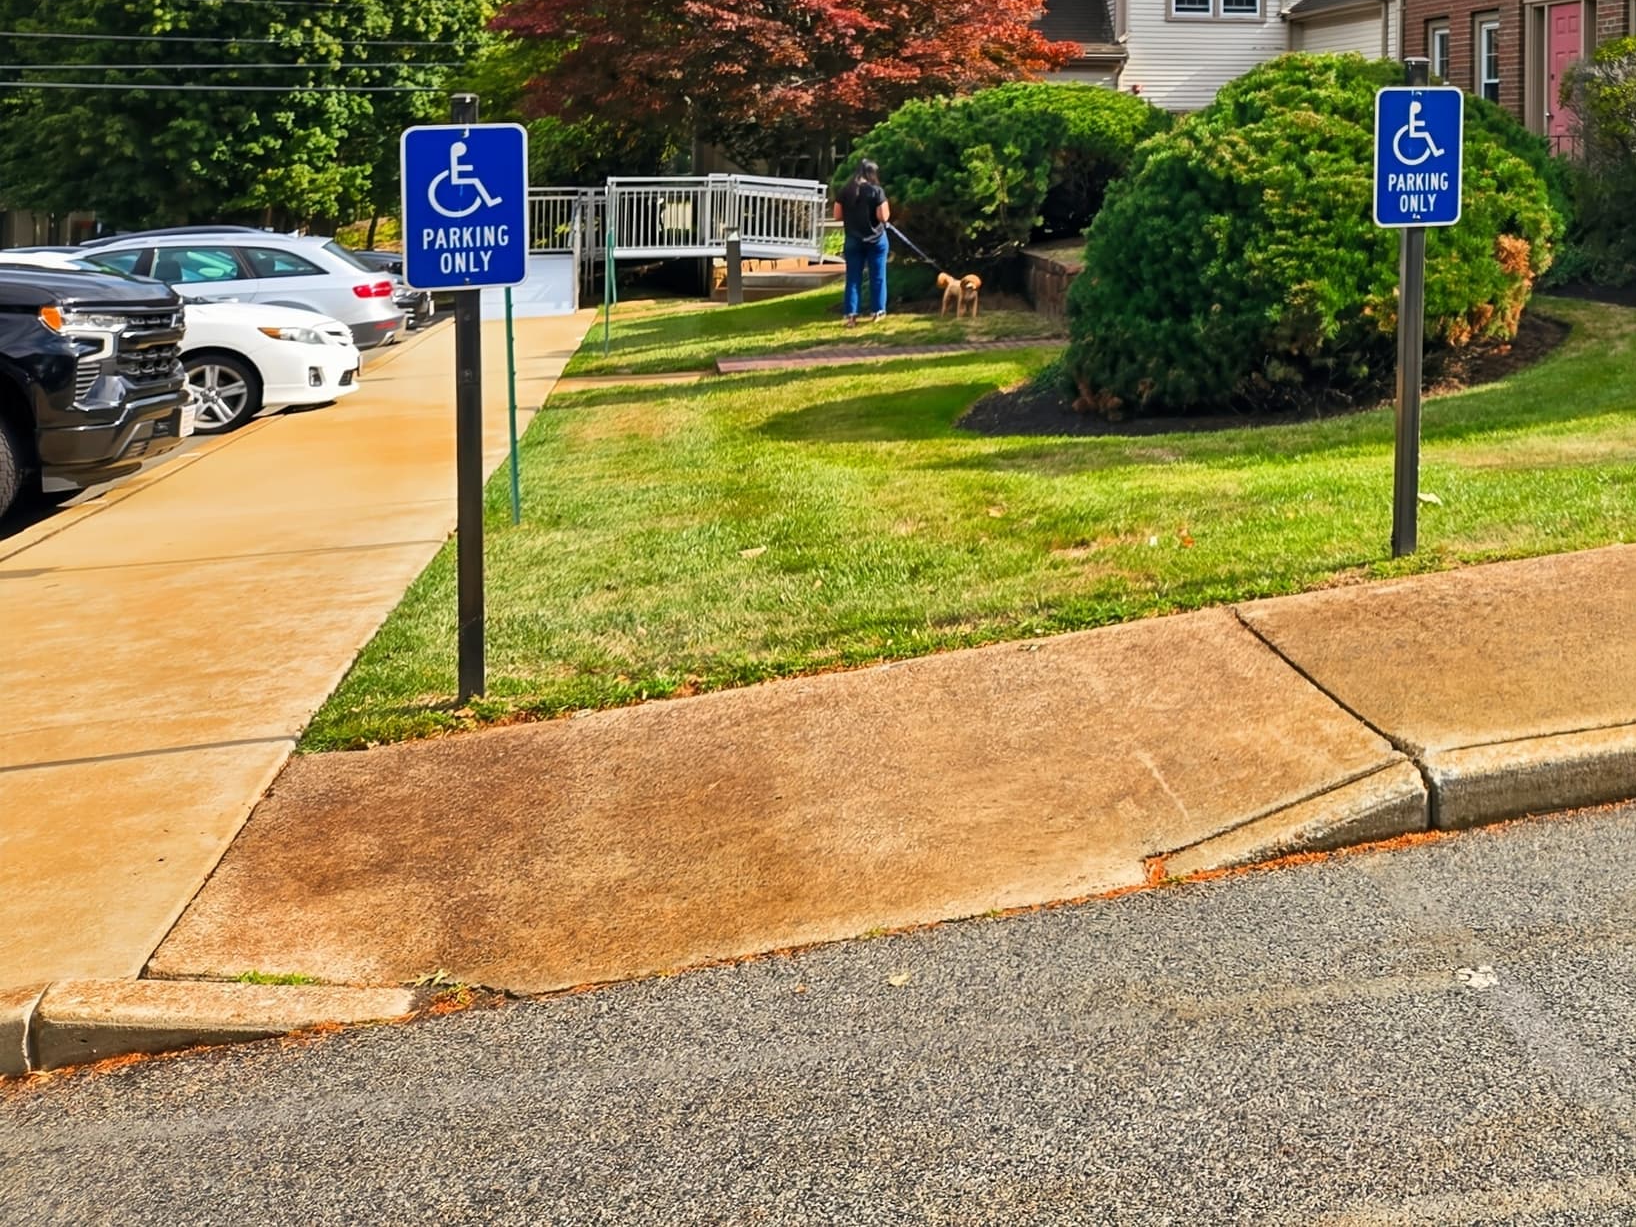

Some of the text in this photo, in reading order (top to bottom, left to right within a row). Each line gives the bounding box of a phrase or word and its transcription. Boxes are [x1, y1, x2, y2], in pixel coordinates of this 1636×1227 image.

[1388, 172, 1449, 192] PARKING
[1400, 193, 1437, 213] ONLY
[423, 225, 509, 250] PARKING
[440, 250, 493, 274] ONLY
